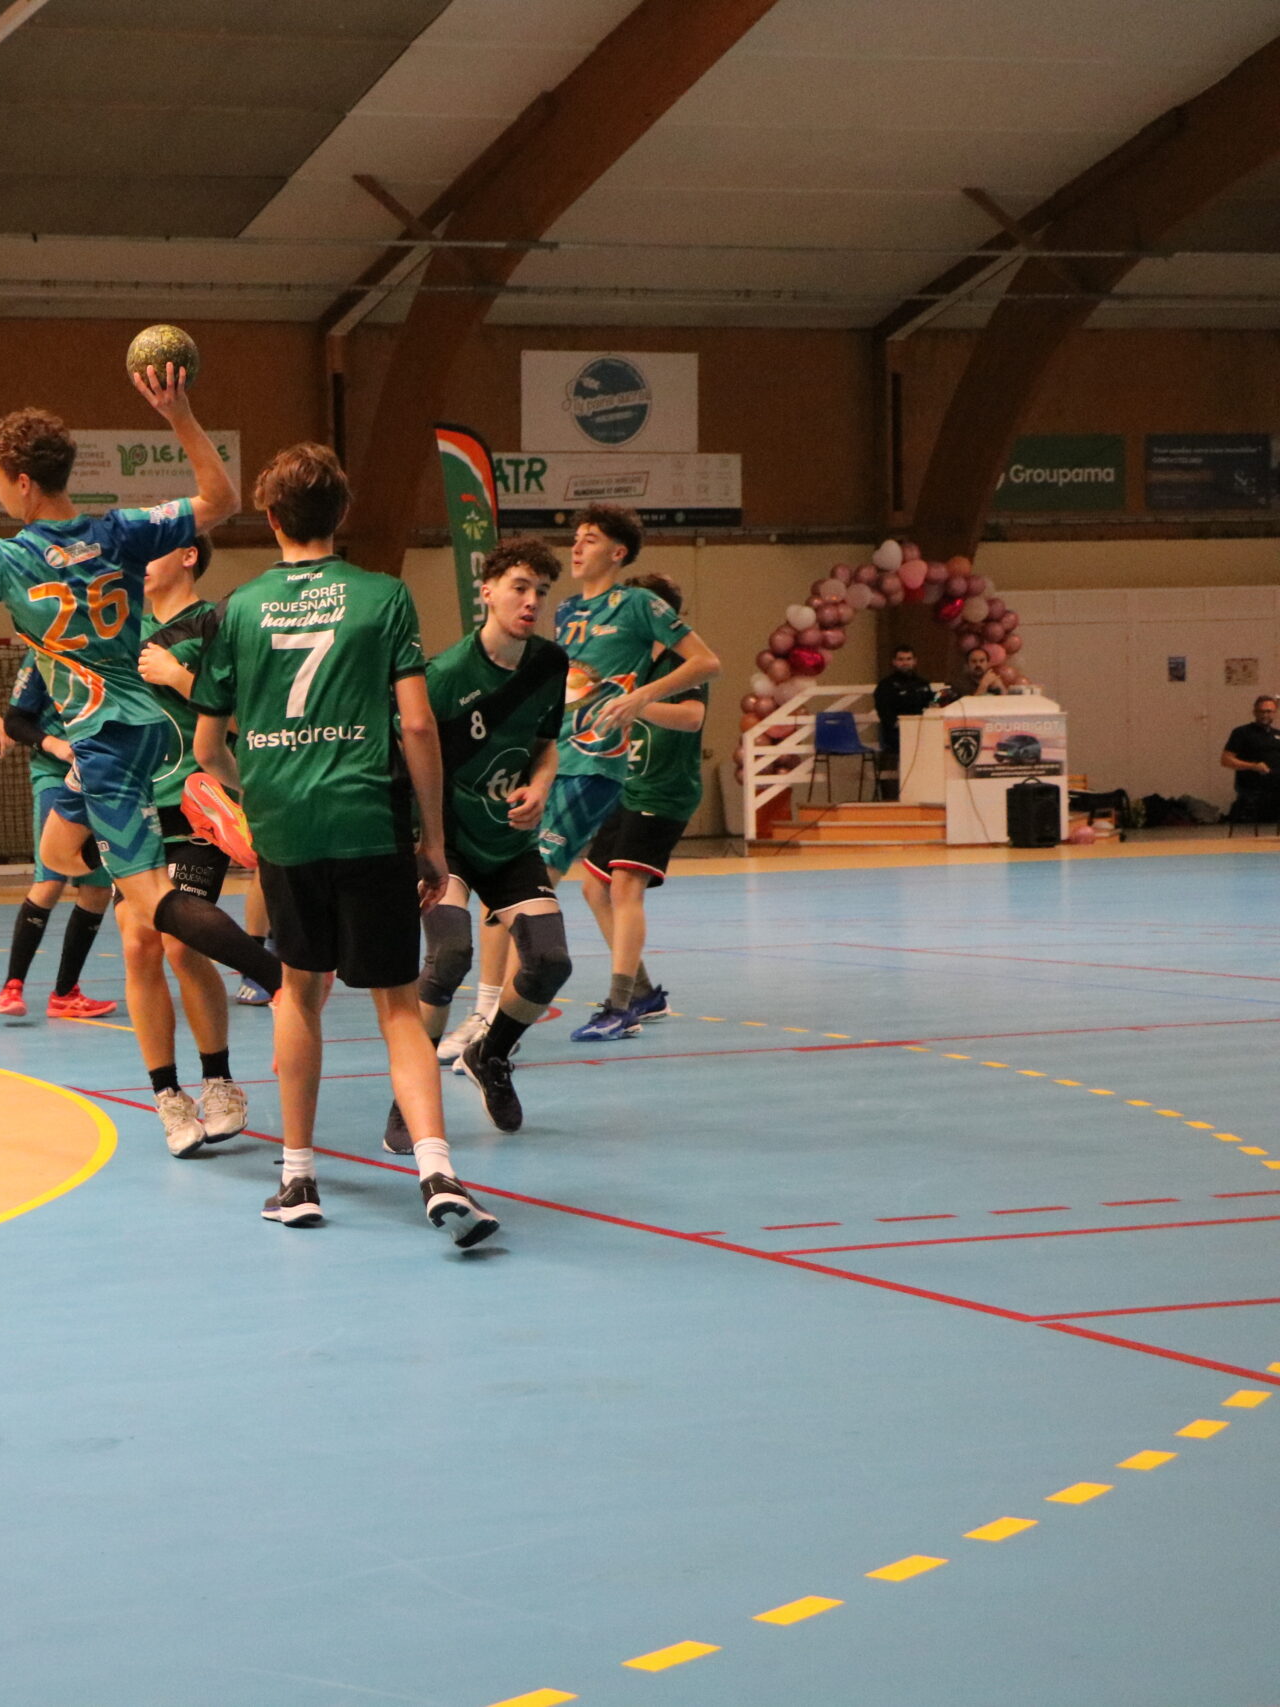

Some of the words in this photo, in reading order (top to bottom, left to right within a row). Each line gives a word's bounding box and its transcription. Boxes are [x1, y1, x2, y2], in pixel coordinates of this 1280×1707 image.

[1009, 463, 1116, 487] Groupama
[286, 571, 324, 582] Kempa
[300, 582, 348, 600] FORÊT
[27, 570, 131, 653] 26
[260, 594, 348, 613] FOUESNANT
[260, 605, 347, 628] handball
[271, 628, 335, 719] 7
[470, 710, 487, 740] 8
